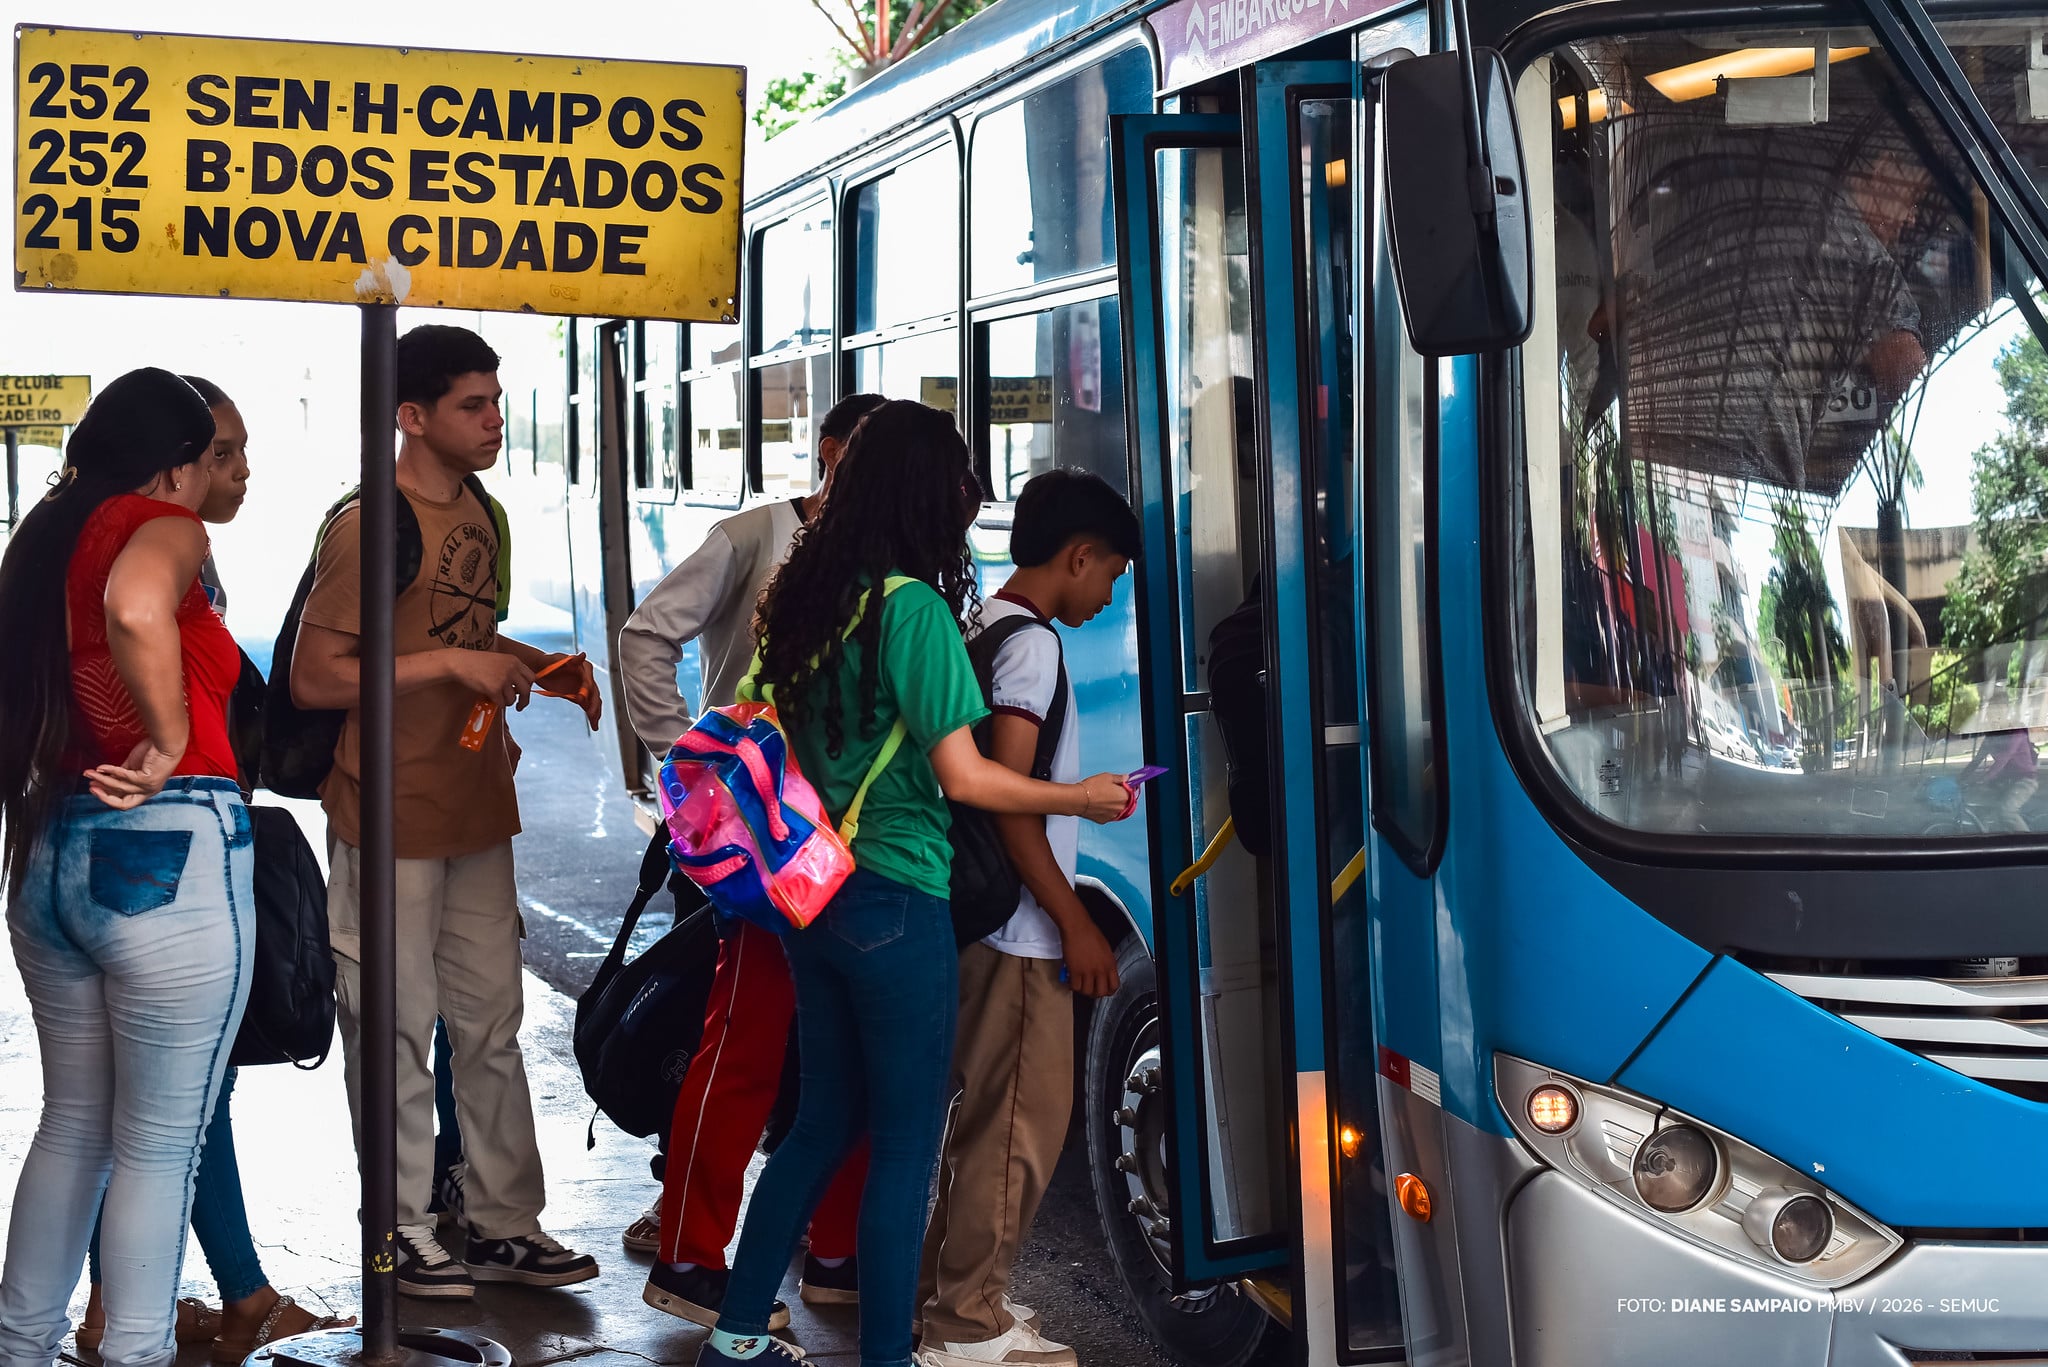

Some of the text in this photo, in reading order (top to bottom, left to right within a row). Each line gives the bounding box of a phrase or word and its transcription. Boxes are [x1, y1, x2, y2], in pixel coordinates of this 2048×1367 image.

[28, 63, 150, 123] 252
[28, 129, 149, 189] 252
[408, 150, 726, 215] ESTADOS
[22, 194, 649, 276] 215 NOVA CIDADE
[14, 376, 64, 390] CLUBE
[0, 409, 61, 421] ADEIRO
[439, 536, 462, 577] REAL
